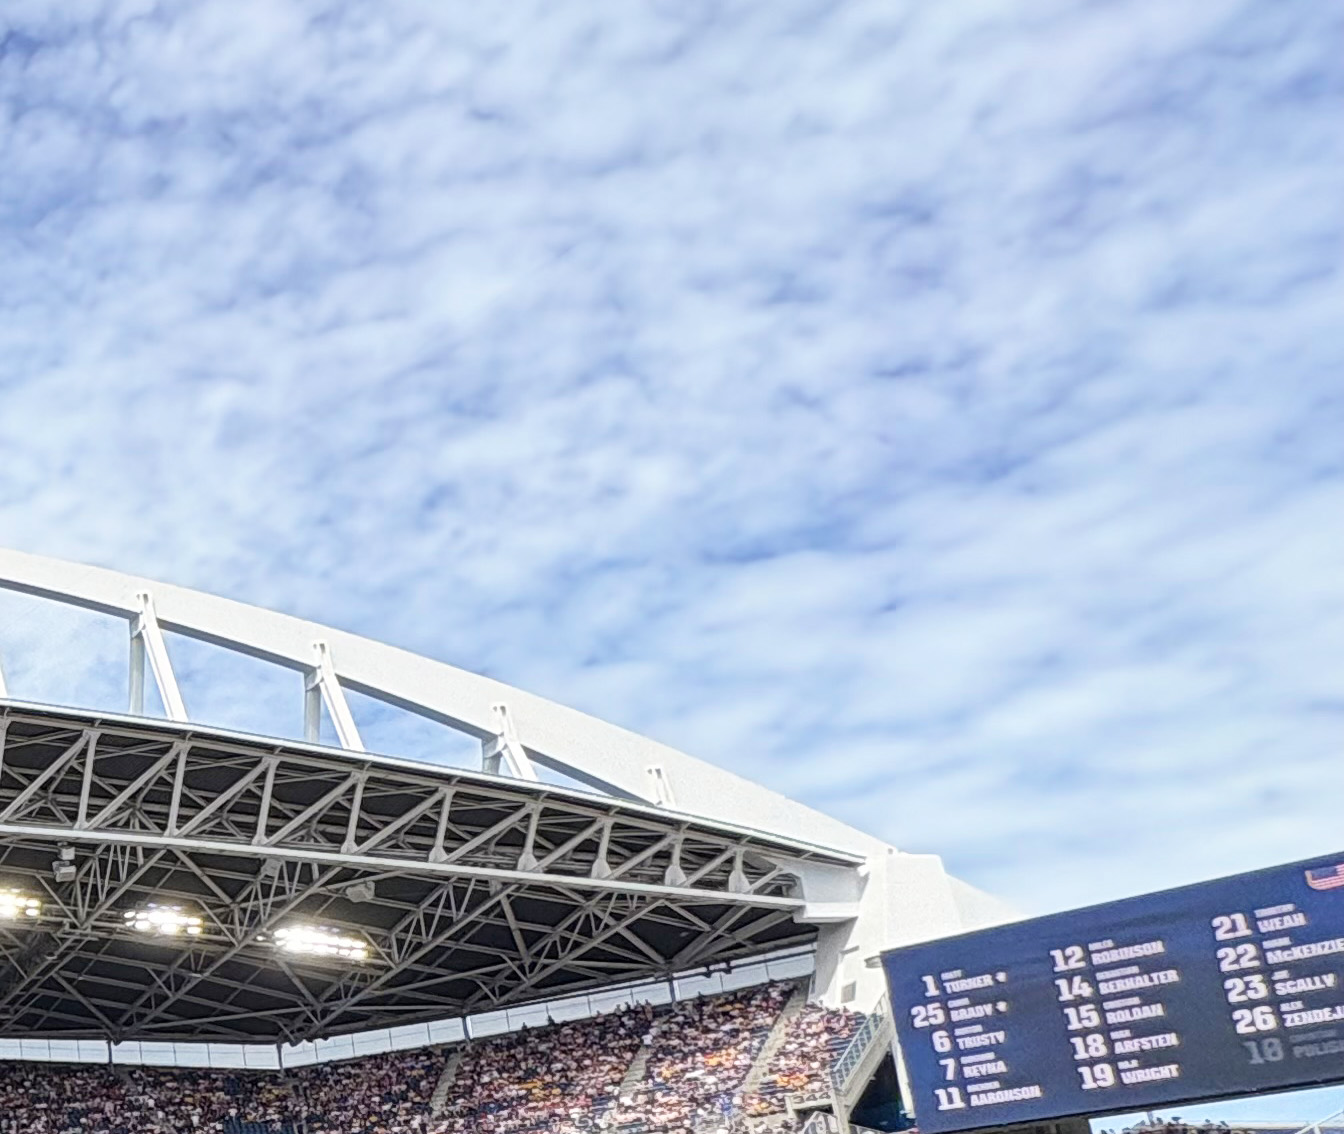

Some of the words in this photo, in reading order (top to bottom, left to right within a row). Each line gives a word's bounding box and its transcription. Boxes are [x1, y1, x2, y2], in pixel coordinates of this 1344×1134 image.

[1212, 912, 1253, 941] 21
[1049, 945, 1086, 972] 12
[1216, 943, 1260, 972] 22
[921, 975, 940, 997] 1
[1054, 975, 1093, 1001] 14
[1224, 974, 1268, 1003] 23
[1274, 973, 1337, 996] SCALLY
[911, 1002, 945, 1028] 25
[1064, 1004, 1100, 1030] 15
[1232, 1006, 1277, 1034] 26
[932, 1030, 952, 1053] 6
[1070, 1033, 1107, 1060] 18
[1114, 1032, 1179, 1054] ARFSTEN
[939, 1058, 955, 1081] 7
[1077, 1063, 1114, 1089] 19
[1120, 1064, 1179, 1085] WRIGHT
[934, 1087, 966, 1111] 11
